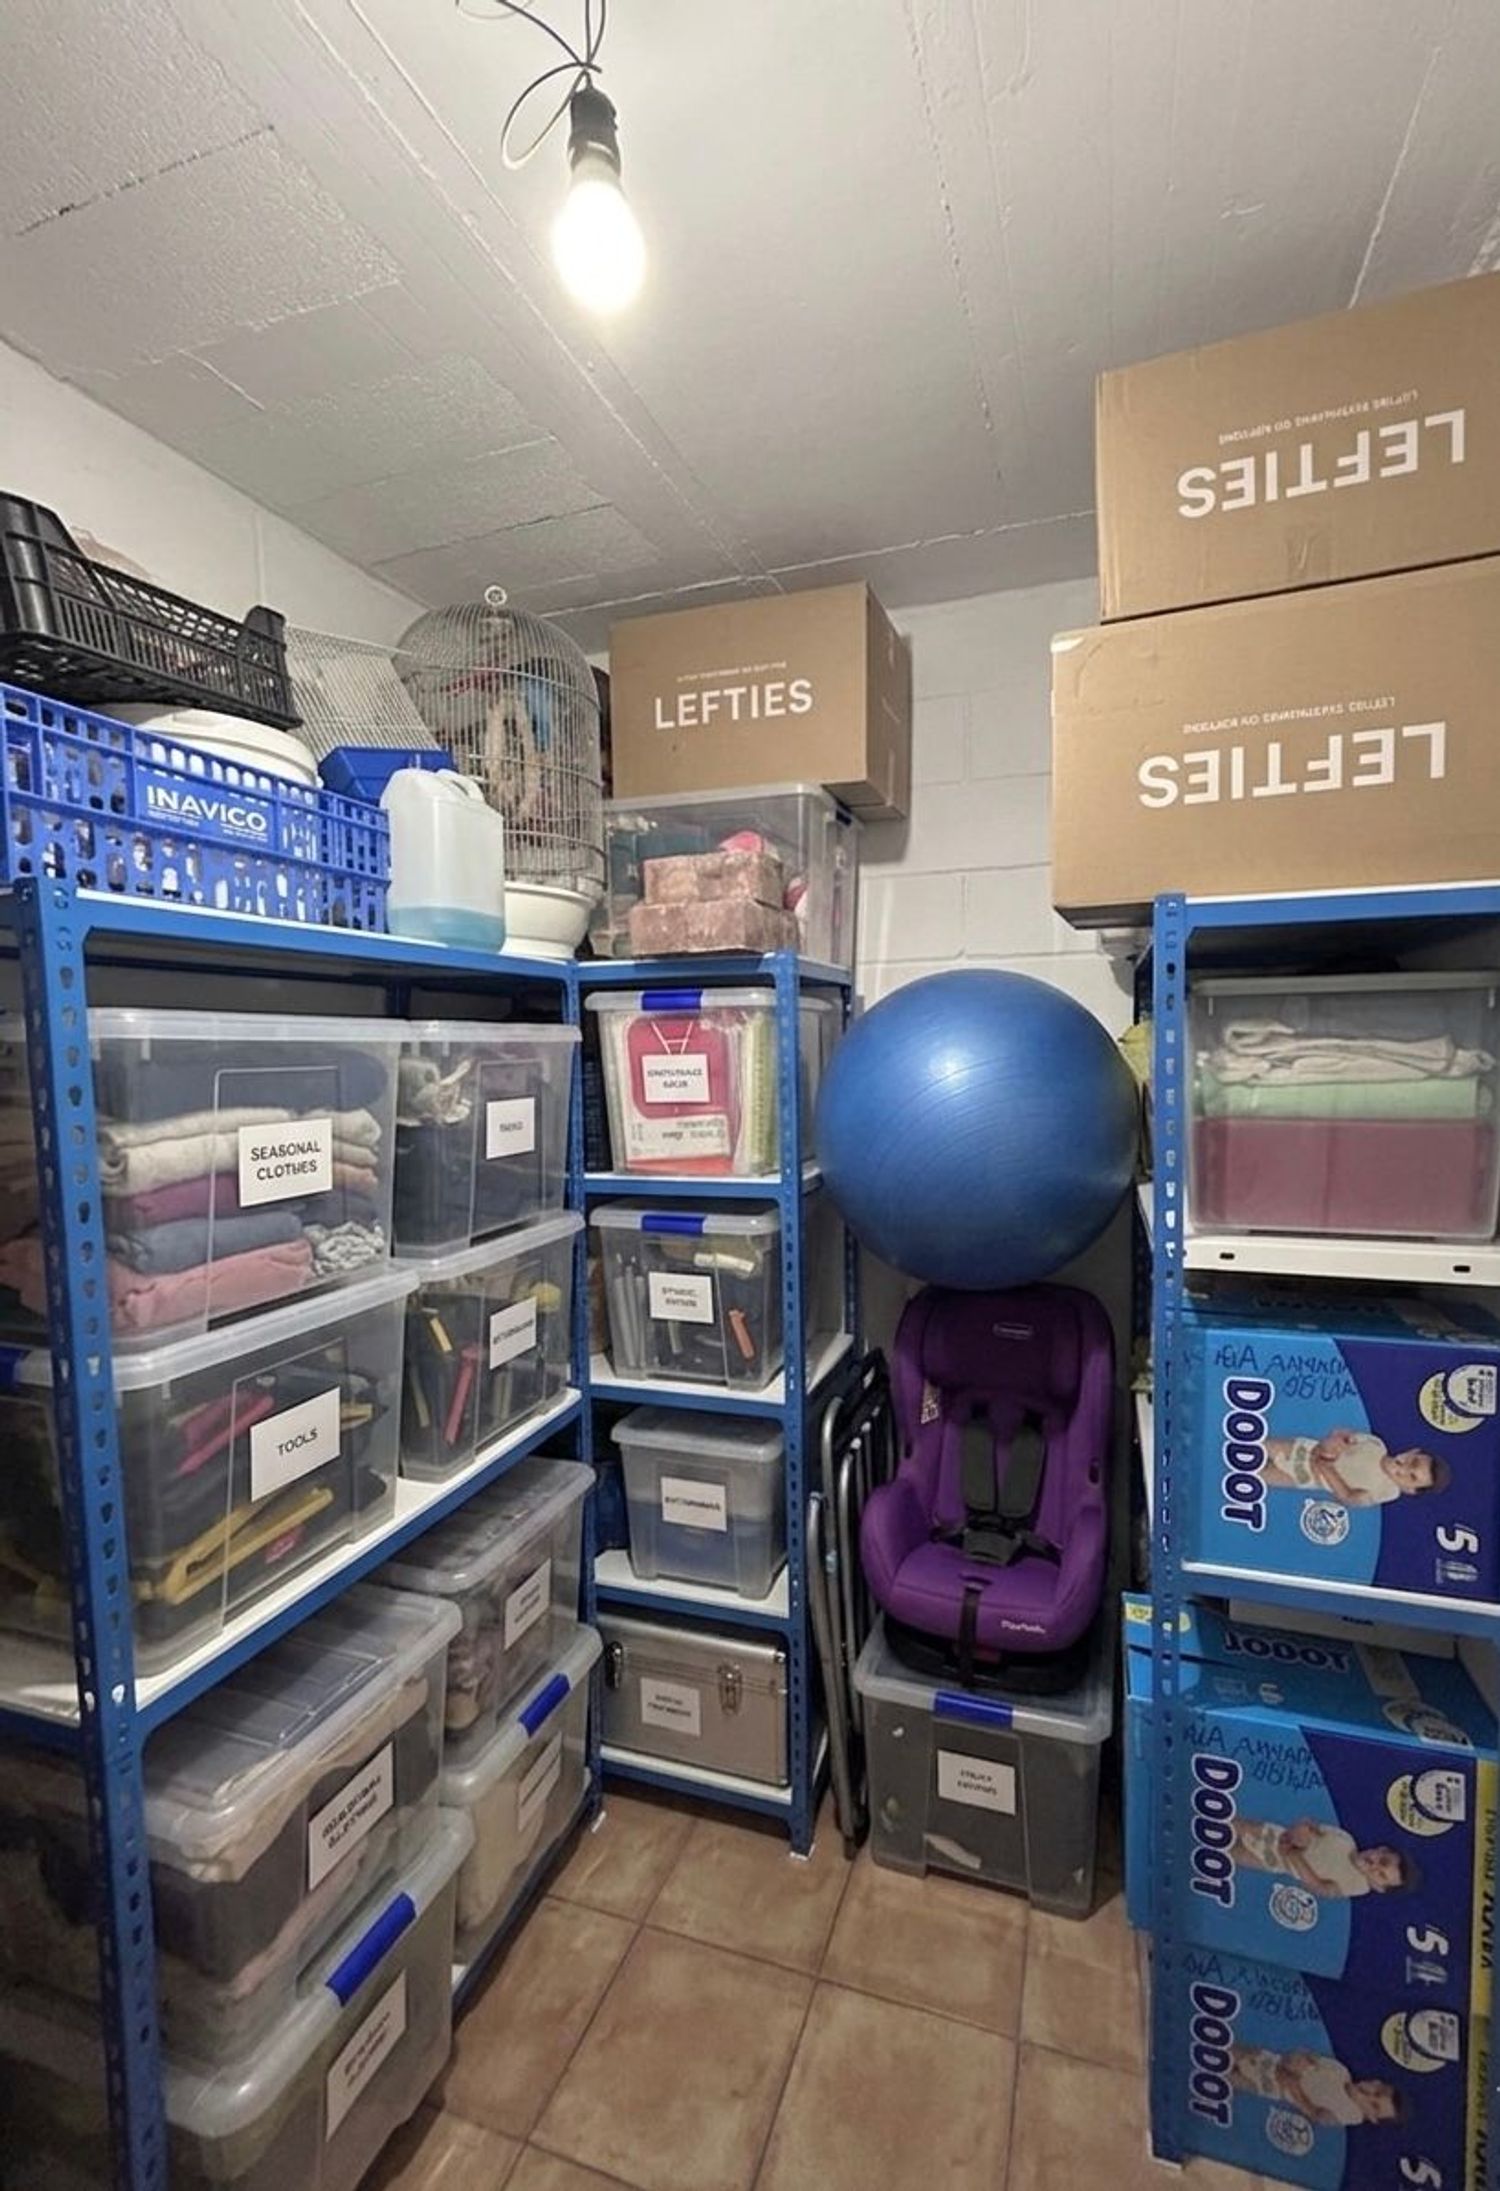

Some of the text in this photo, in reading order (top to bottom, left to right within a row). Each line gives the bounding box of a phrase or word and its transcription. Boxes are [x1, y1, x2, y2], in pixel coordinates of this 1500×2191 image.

[1177, 408, 1467, 519] LEFTIES
[654, 678, 815, 731] LEFTIES
[1137, 721, 1448, 809] LEFTIES
[146, 785, 267, 832] INAVICO
[251, 1140, 322, 1163] SEASONAL
[276, 1428, 319, 1457] TOOLS
[1222, 1376, 1275, 1532] DODOT
[1436, 1526, 1479, 1555] 5
[1191, 1753, 1244, 1908] DODOT
[1407, 1925, 1448, 1956] 5
[1188, 1981, 1241, 2129] DODOT
